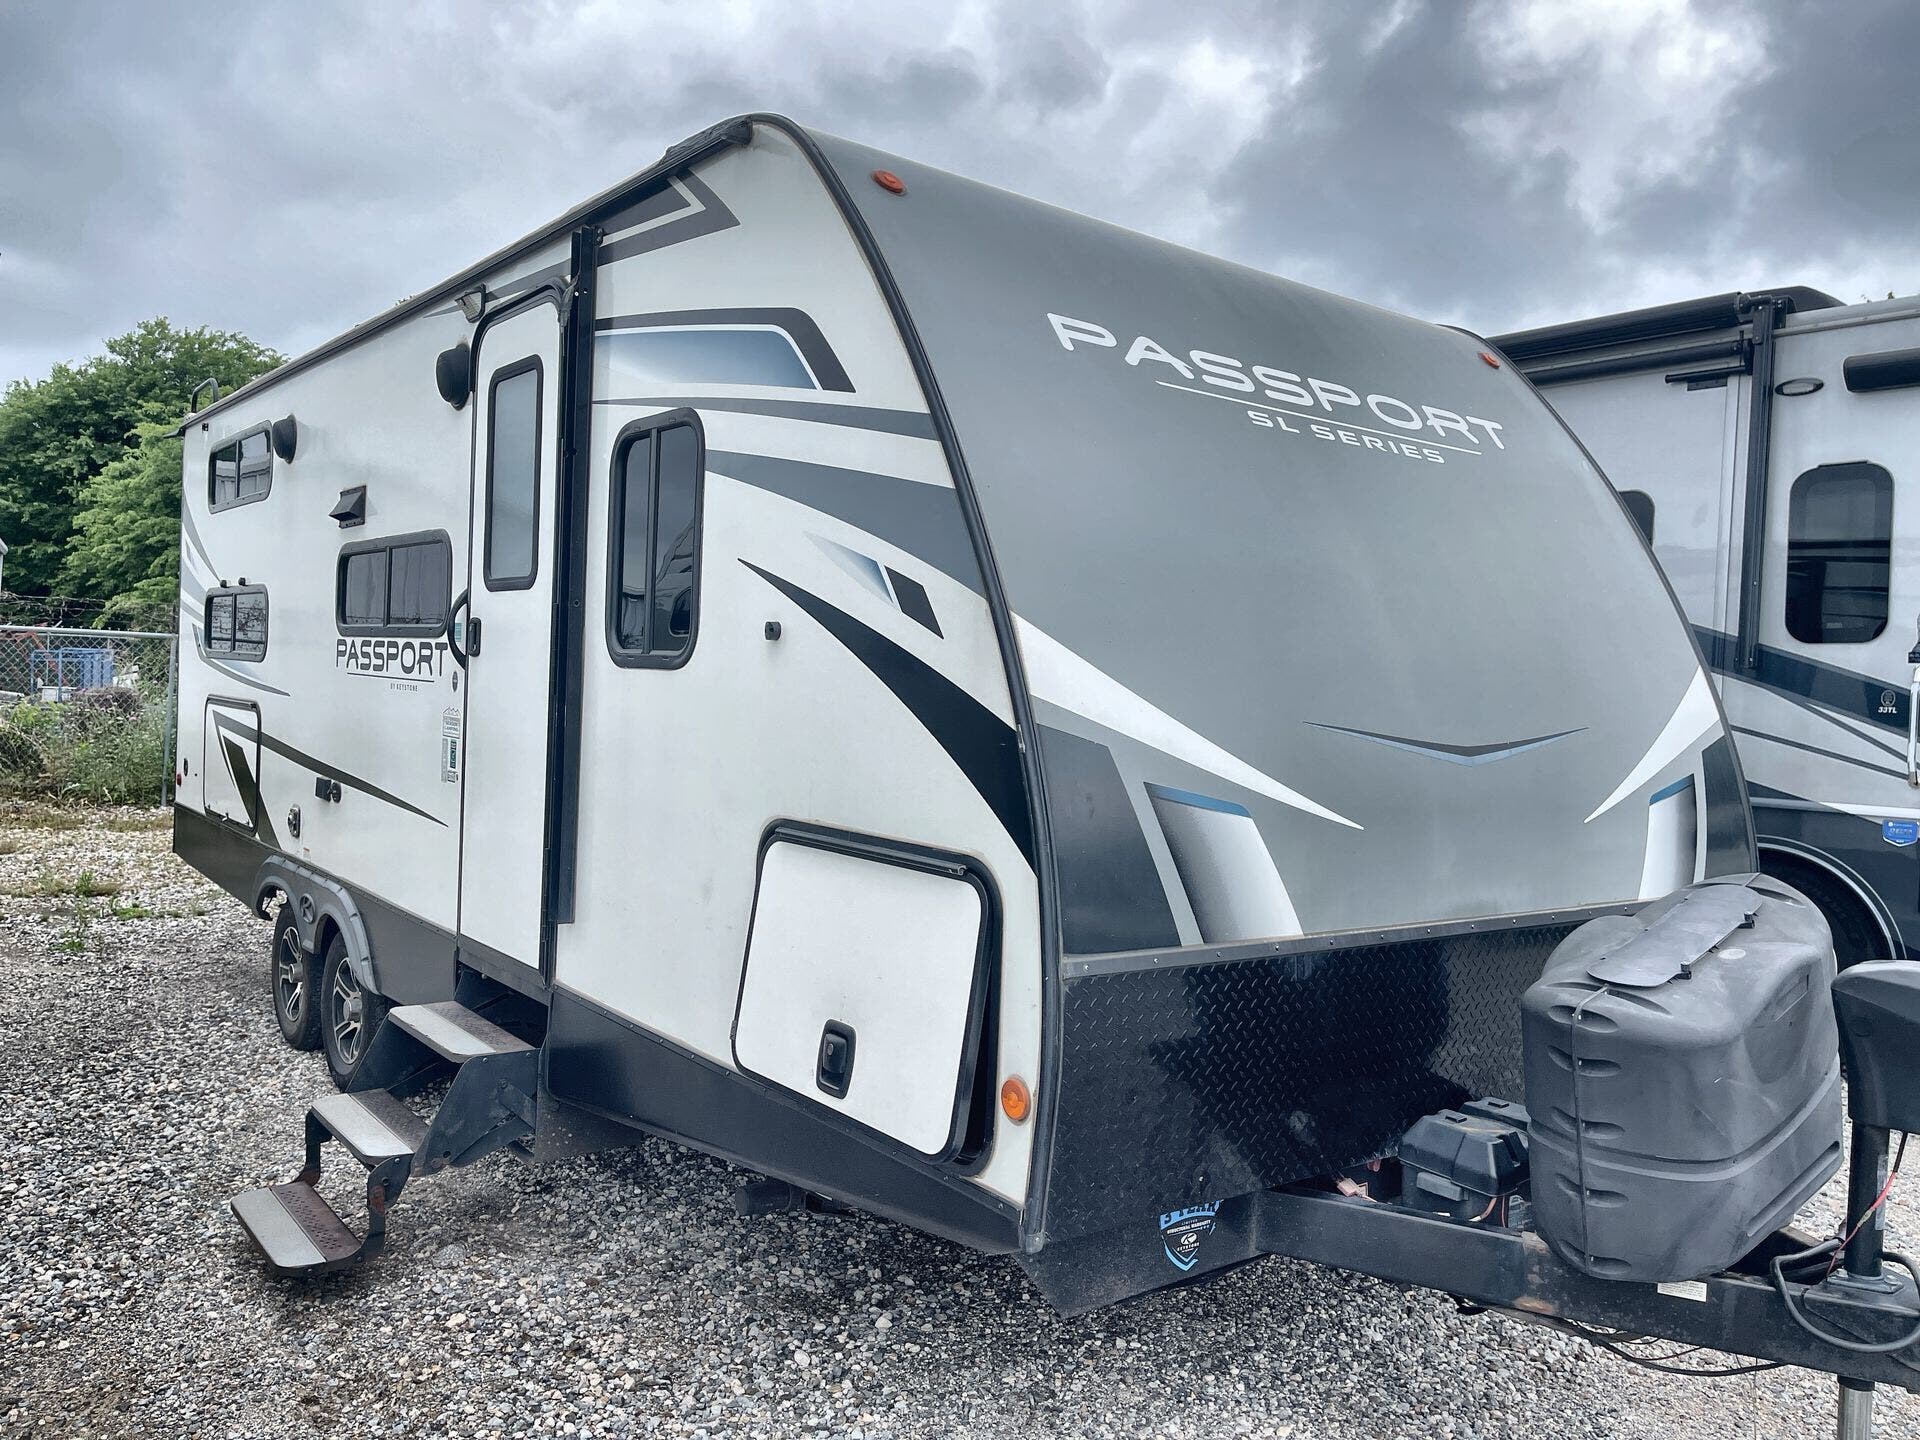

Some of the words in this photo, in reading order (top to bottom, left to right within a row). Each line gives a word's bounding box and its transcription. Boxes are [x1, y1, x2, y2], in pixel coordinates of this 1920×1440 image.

[1047, 312, 1505, 450] PASSPORT
[1247, 410, 1300, 433] SL
[1310, 424, 1445, 463] SERIES
[336, 638, 449, 677] PASSPORT
